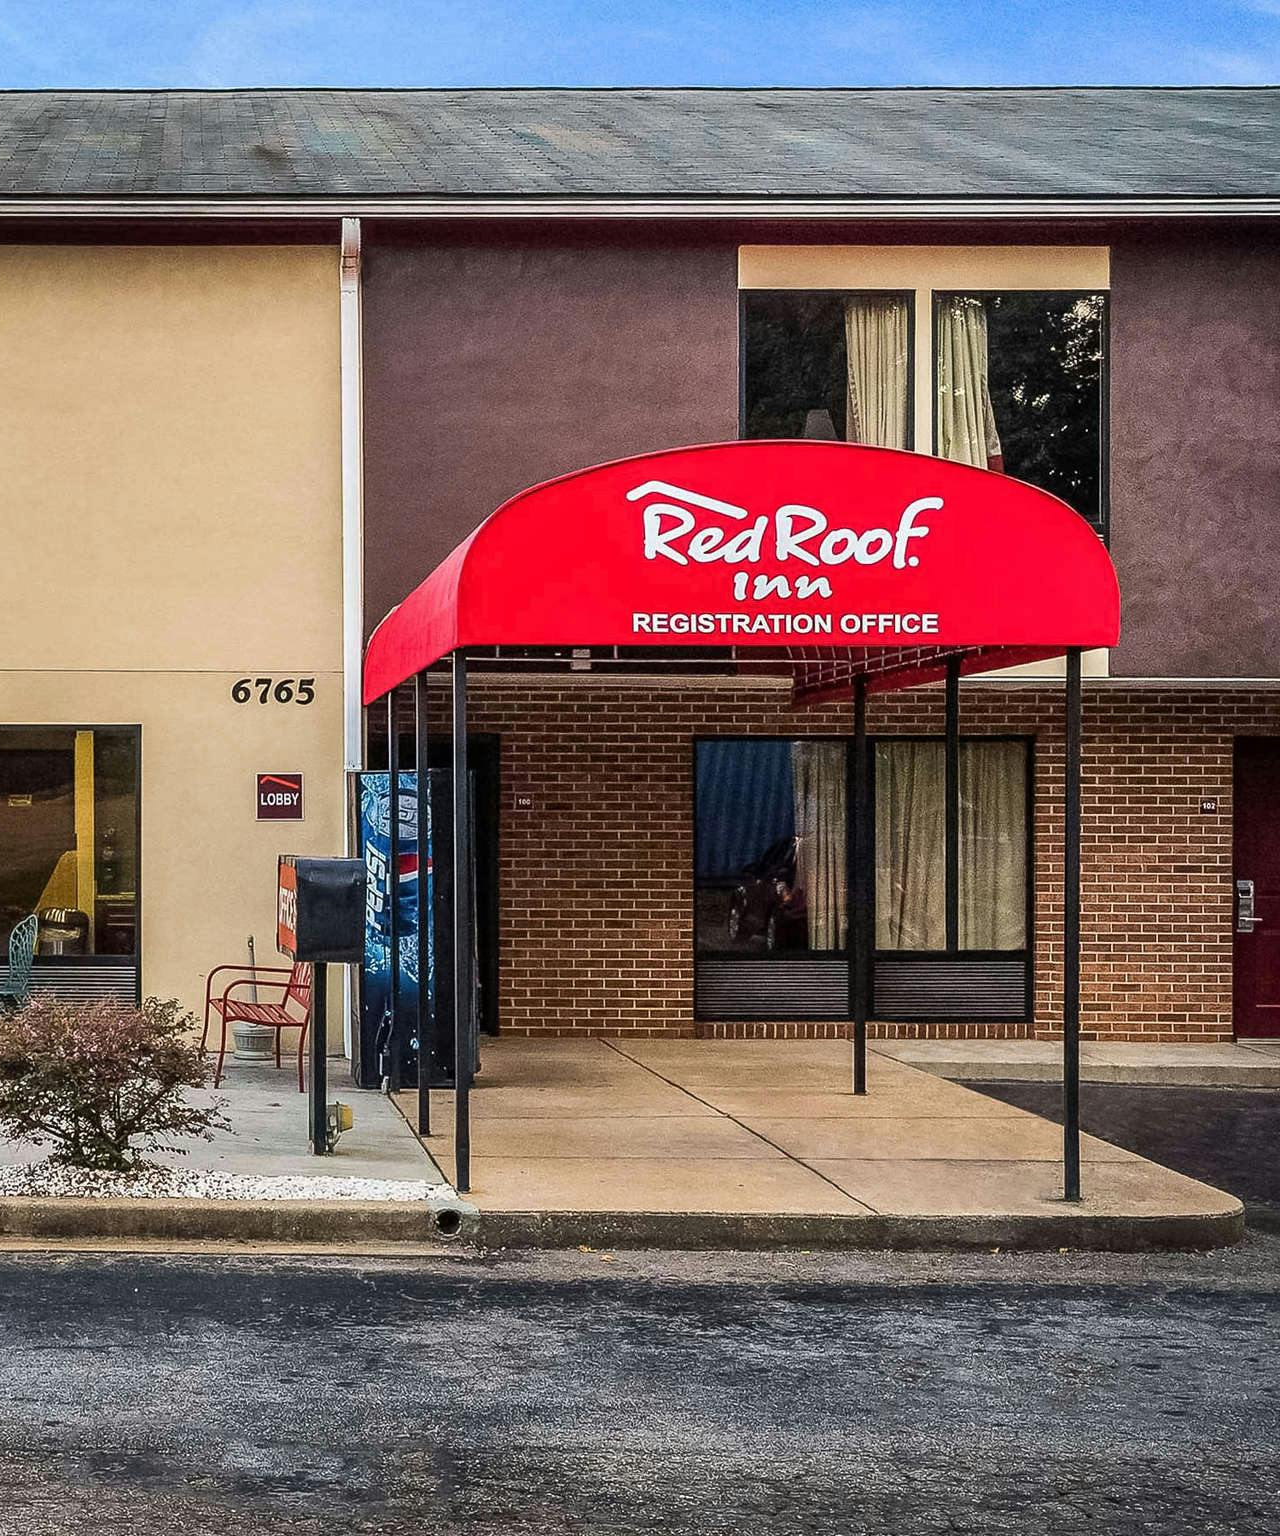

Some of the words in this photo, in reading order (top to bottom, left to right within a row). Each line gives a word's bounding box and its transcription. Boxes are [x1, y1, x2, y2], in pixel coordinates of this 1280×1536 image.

[643, 502, 769, 566] Red
[733, 572, 833, 601] Inn
[632, 613, 832, 633] REGISTRATION
[840, 613, 939, 633] OFFICE
[232, 678, 315, 705] 6765
[260, 793, 300, 806] LOBBY
[1202, 802, 1216, 810] 102
[365, 840, 387, 931] PEPSI
